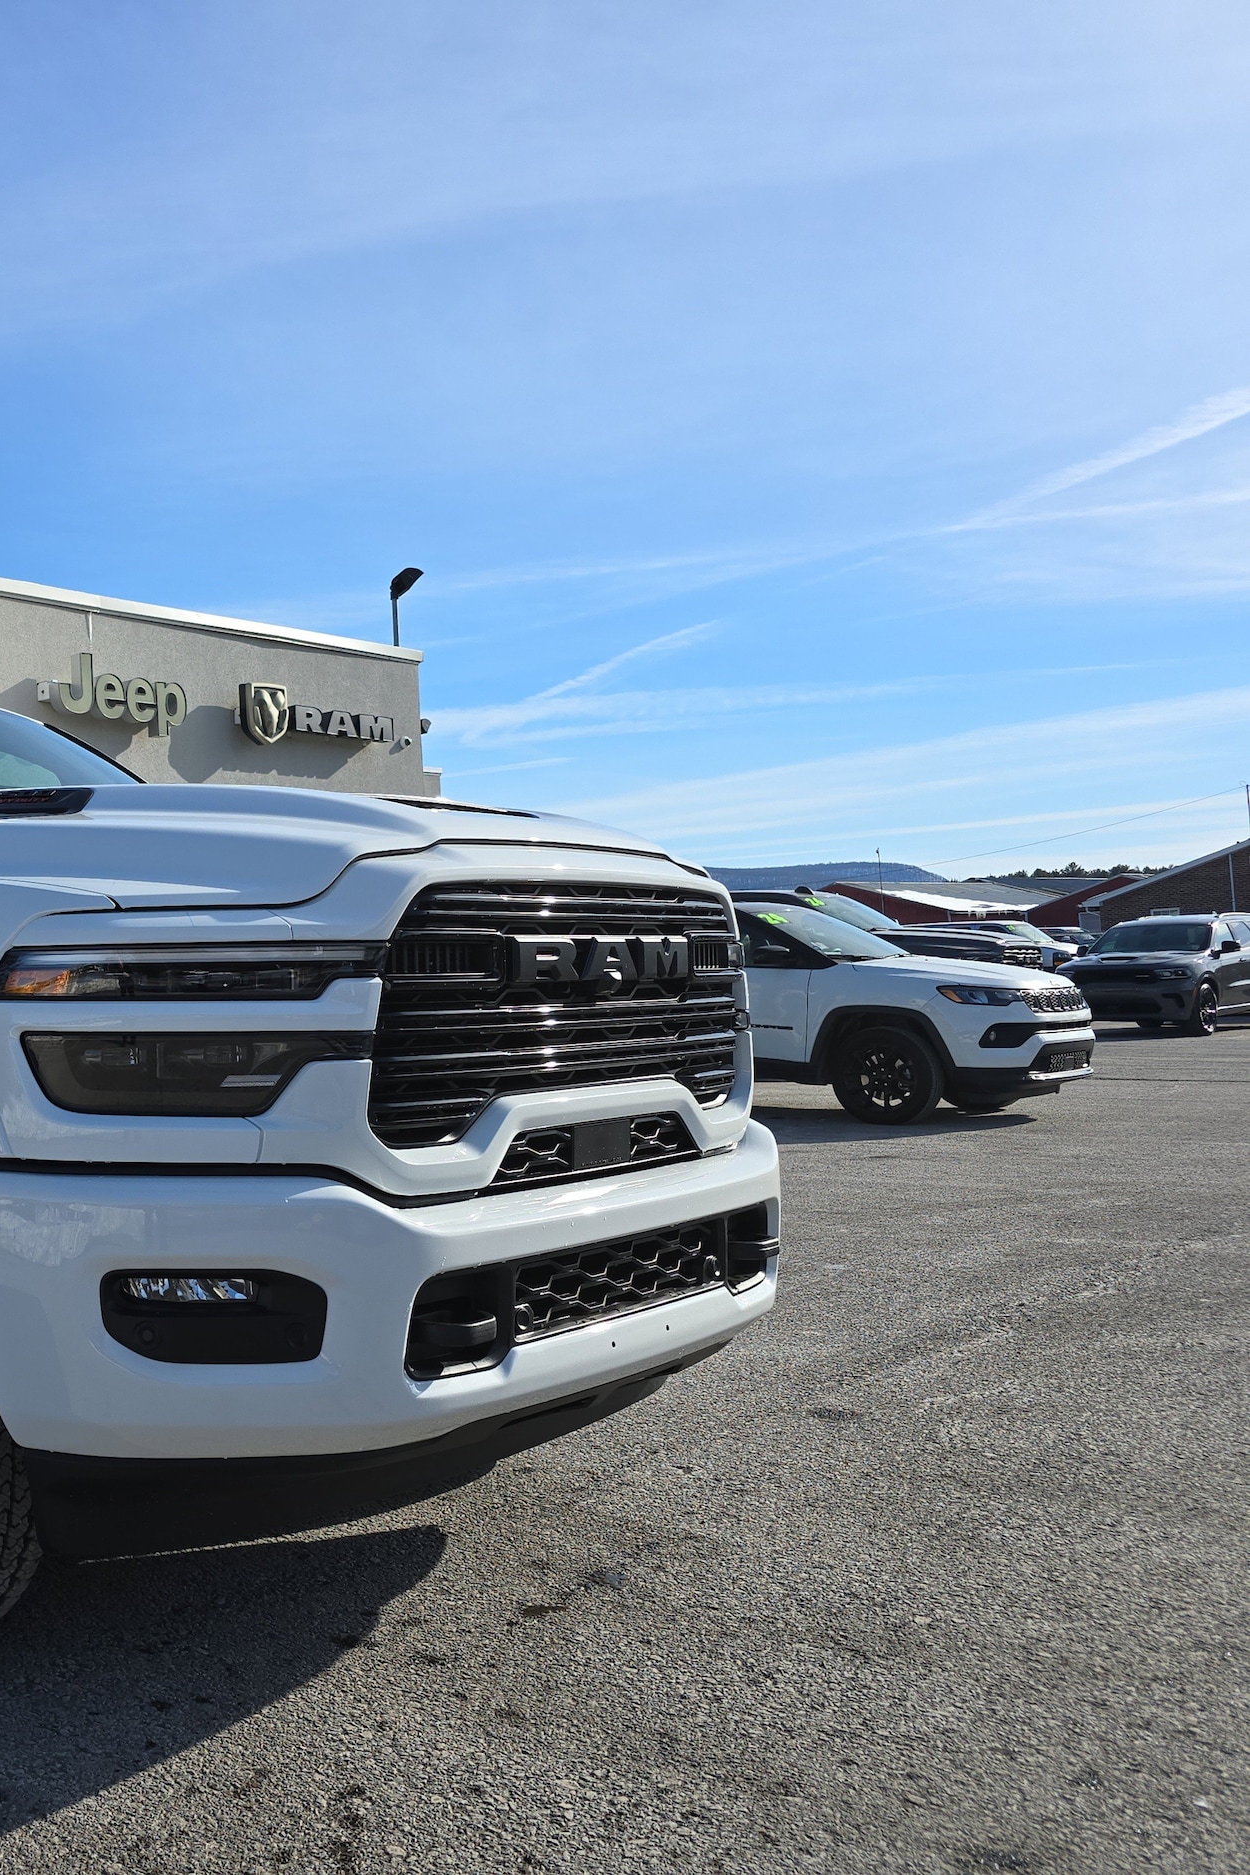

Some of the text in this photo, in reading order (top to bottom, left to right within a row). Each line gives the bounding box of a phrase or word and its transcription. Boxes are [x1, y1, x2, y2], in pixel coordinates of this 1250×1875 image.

[54, 652, 187, 738] Jeep
[291, 704, 395, 742] RAM
[512, 935, 688, 984] RAM
